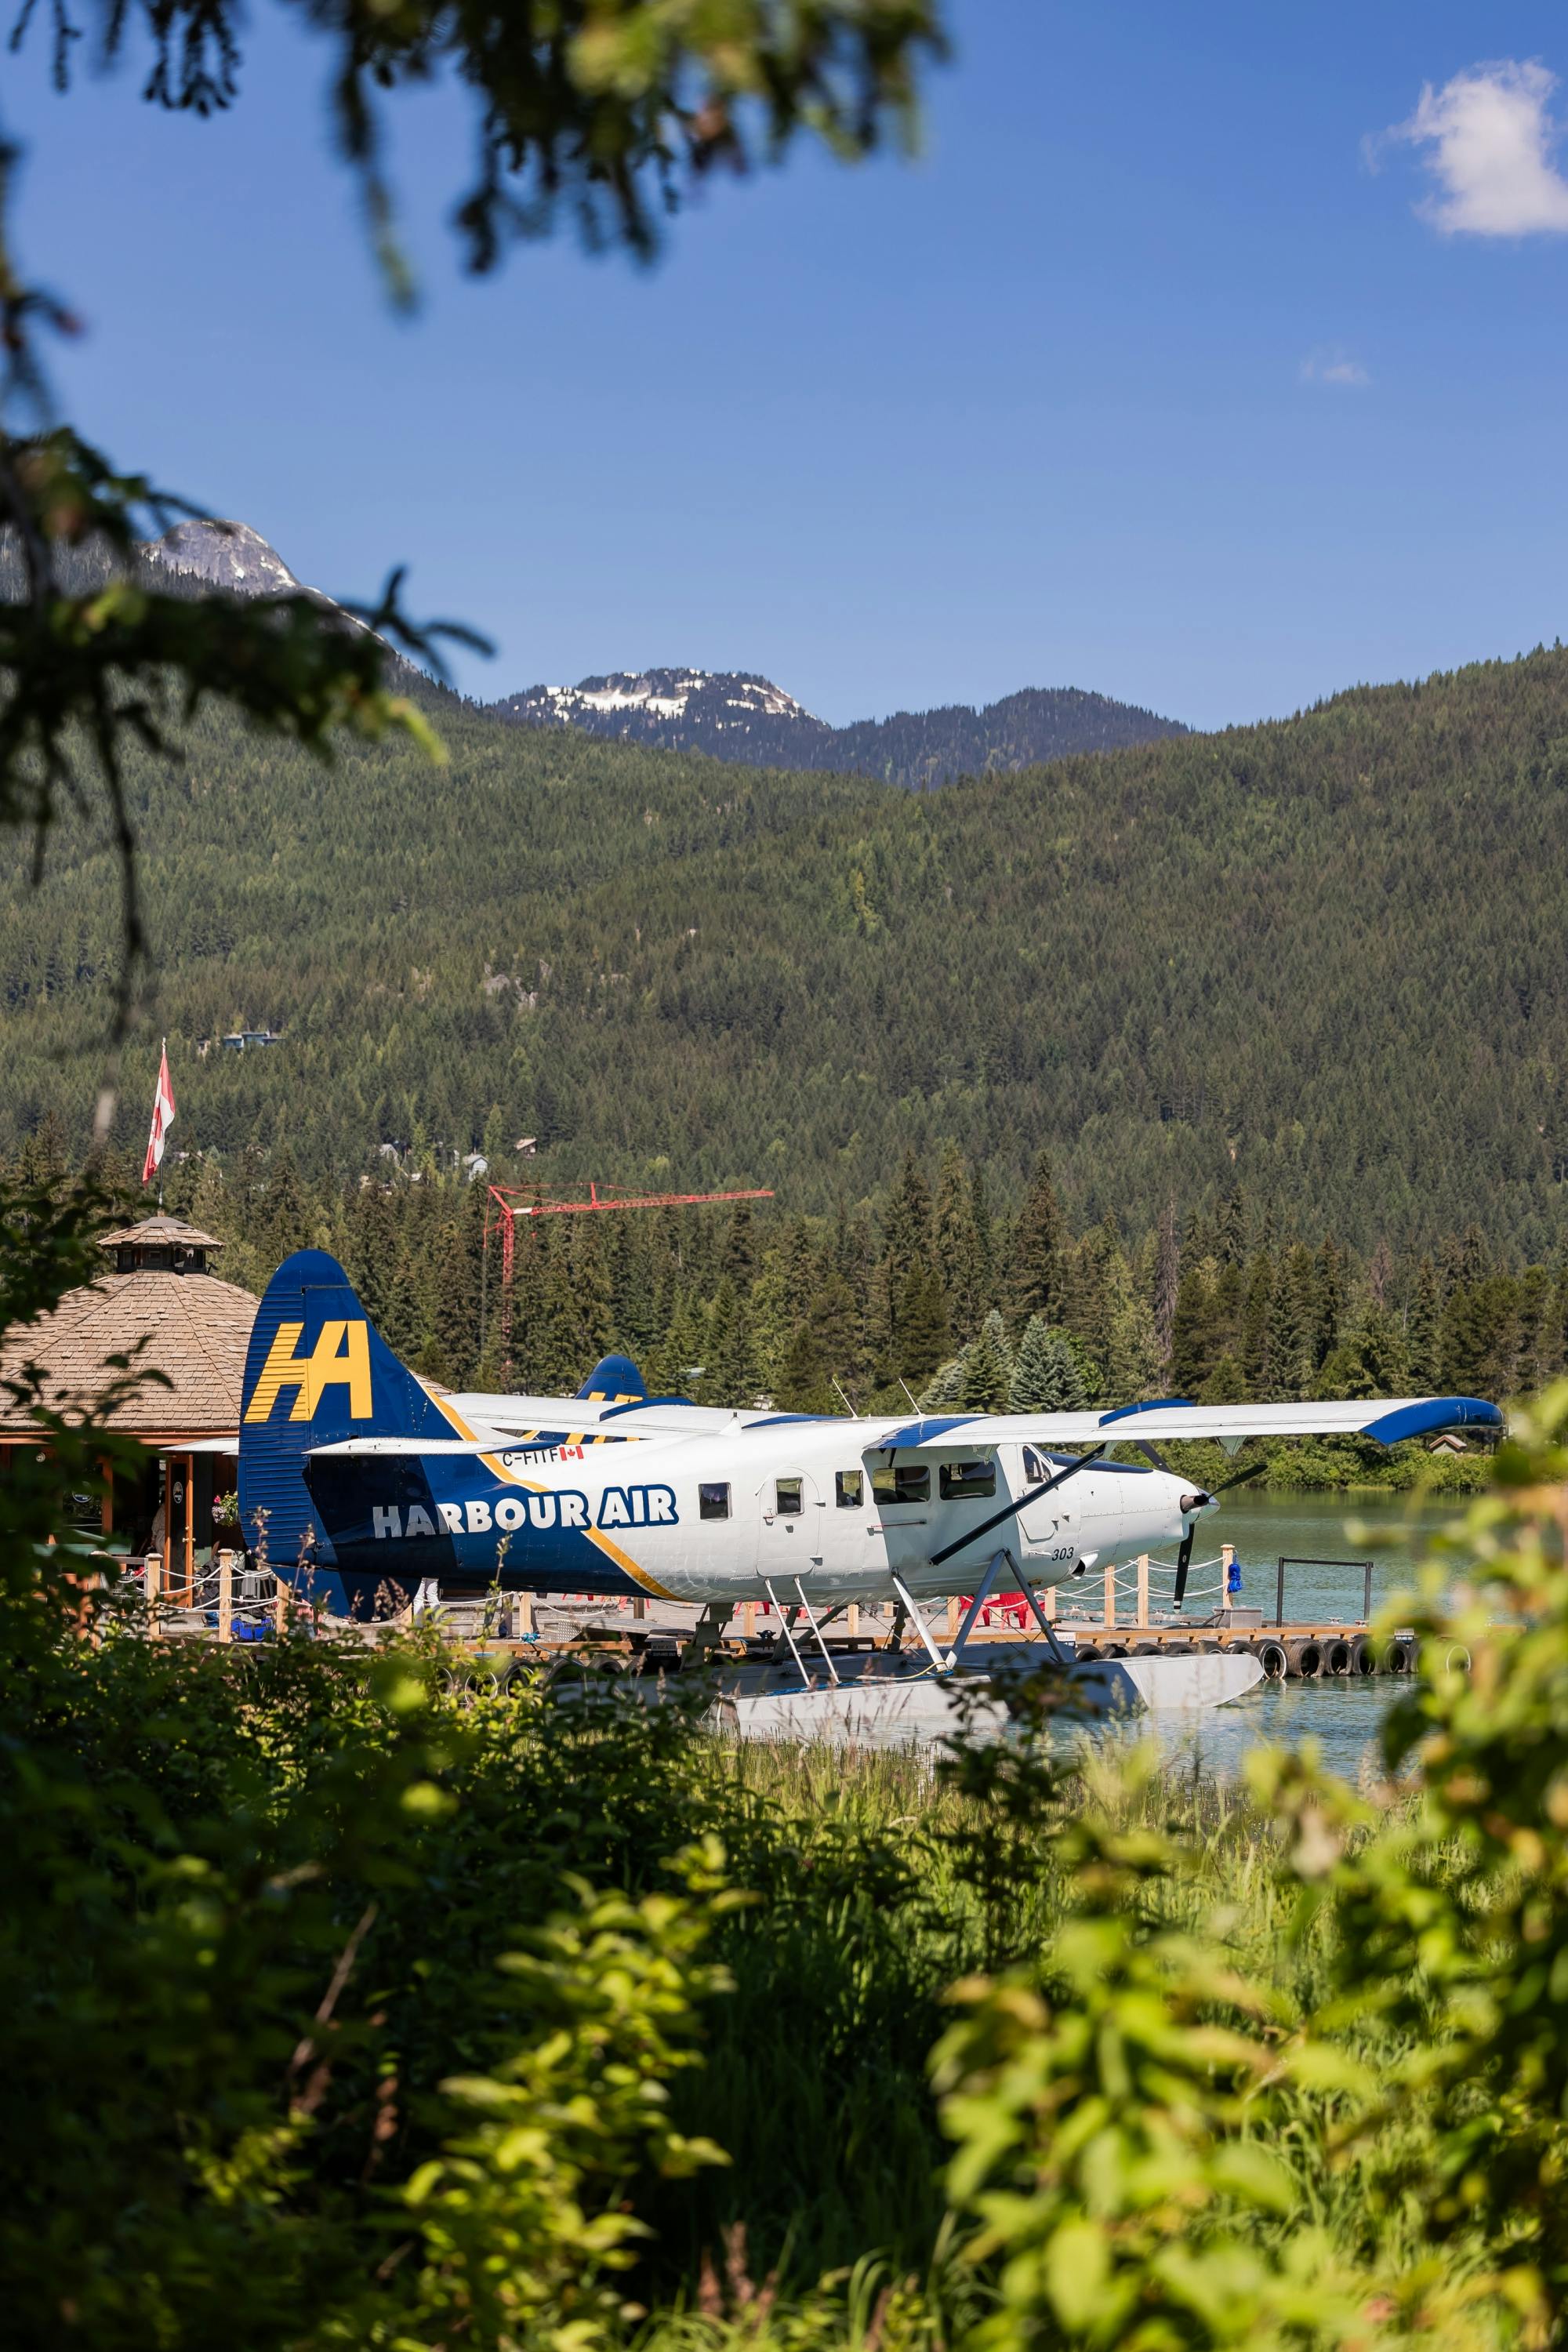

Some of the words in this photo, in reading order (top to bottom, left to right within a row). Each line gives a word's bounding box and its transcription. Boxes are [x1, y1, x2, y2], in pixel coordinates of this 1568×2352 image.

[243, 1320, 372, 1423] HA
[503, 1448, 557, 1467] C-FITF
[372, 1494, 585, 1539] HARBOUR
[601, 1489, 675, 1525] AIR
[1051, 1546, 1074, 1562] 303
